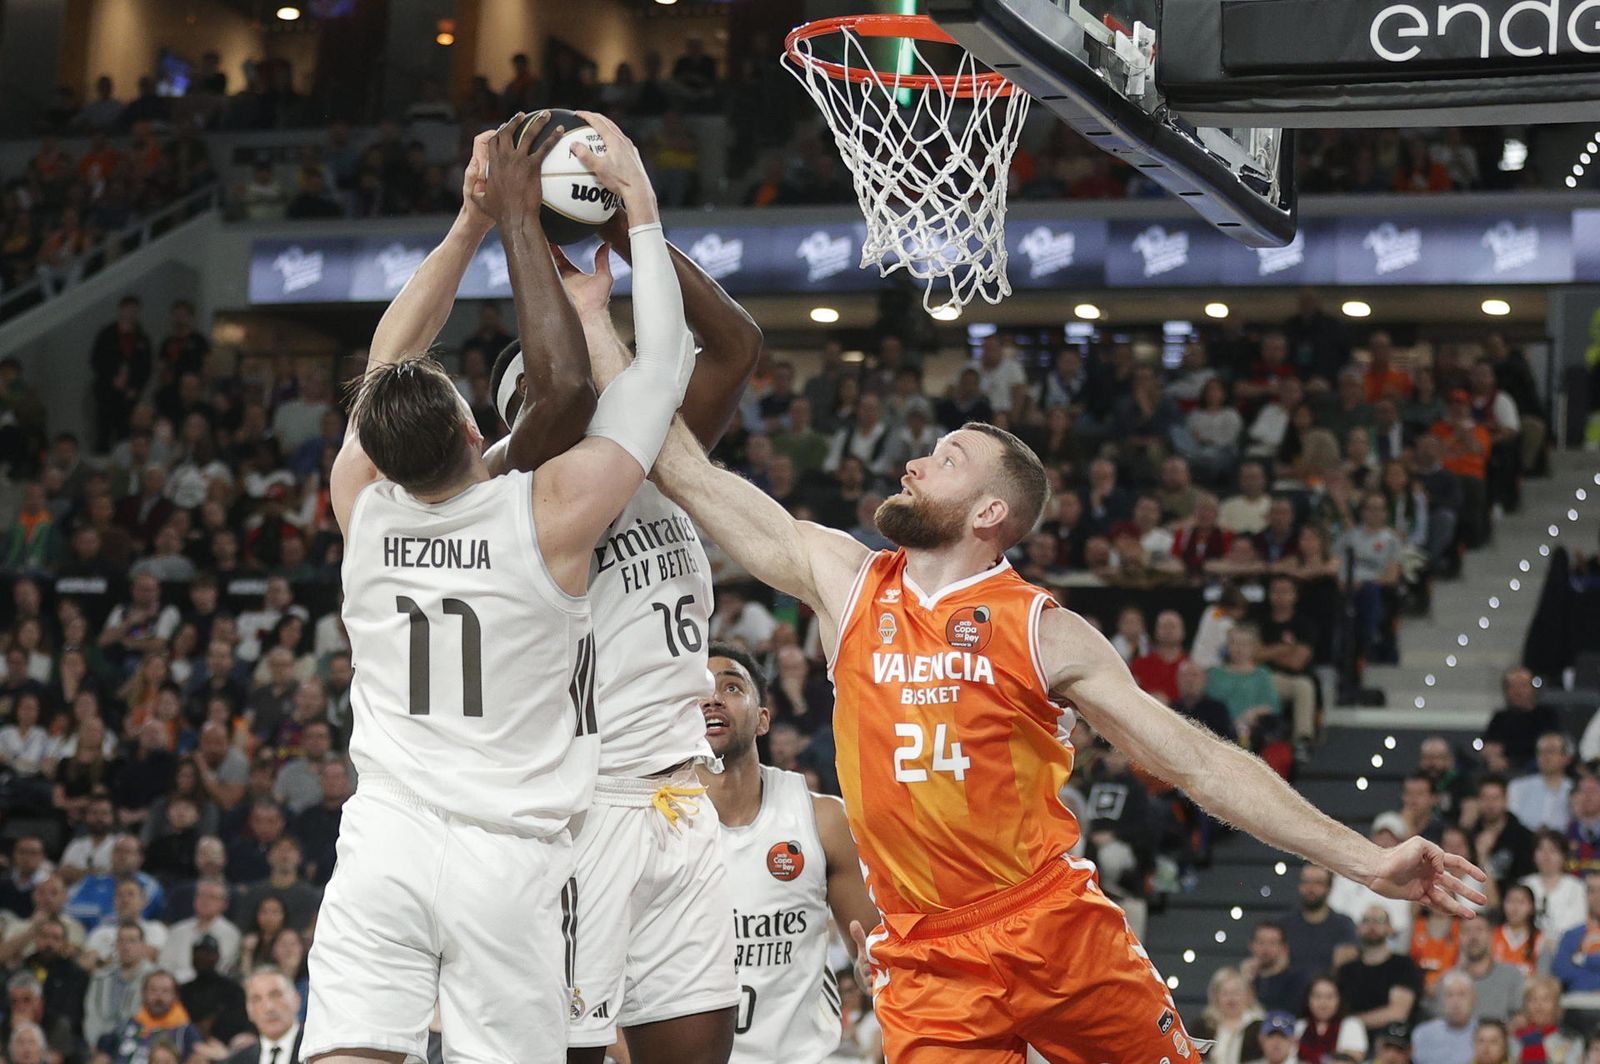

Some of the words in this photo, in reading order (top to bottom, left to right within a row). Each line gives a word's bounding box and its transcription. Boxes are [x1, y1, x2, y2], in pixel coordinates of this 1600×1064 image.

[1369, 0, 1600, 62] ende
[571, 183, 626, 211] ilson
[384, 537, 491, 569] HEZONJA
[621, 558, 651, 594] FLY
[652, 594, 702, 658] 16
[954, 625, 977, 634] Copa
[964, 634, 979, 643] Rey
[396, 595, 483, 717] 11
[901, 685, 960, 705] BSKET
[894, 723, 971, 783] 24
[733, 908, 807, 939] irates
